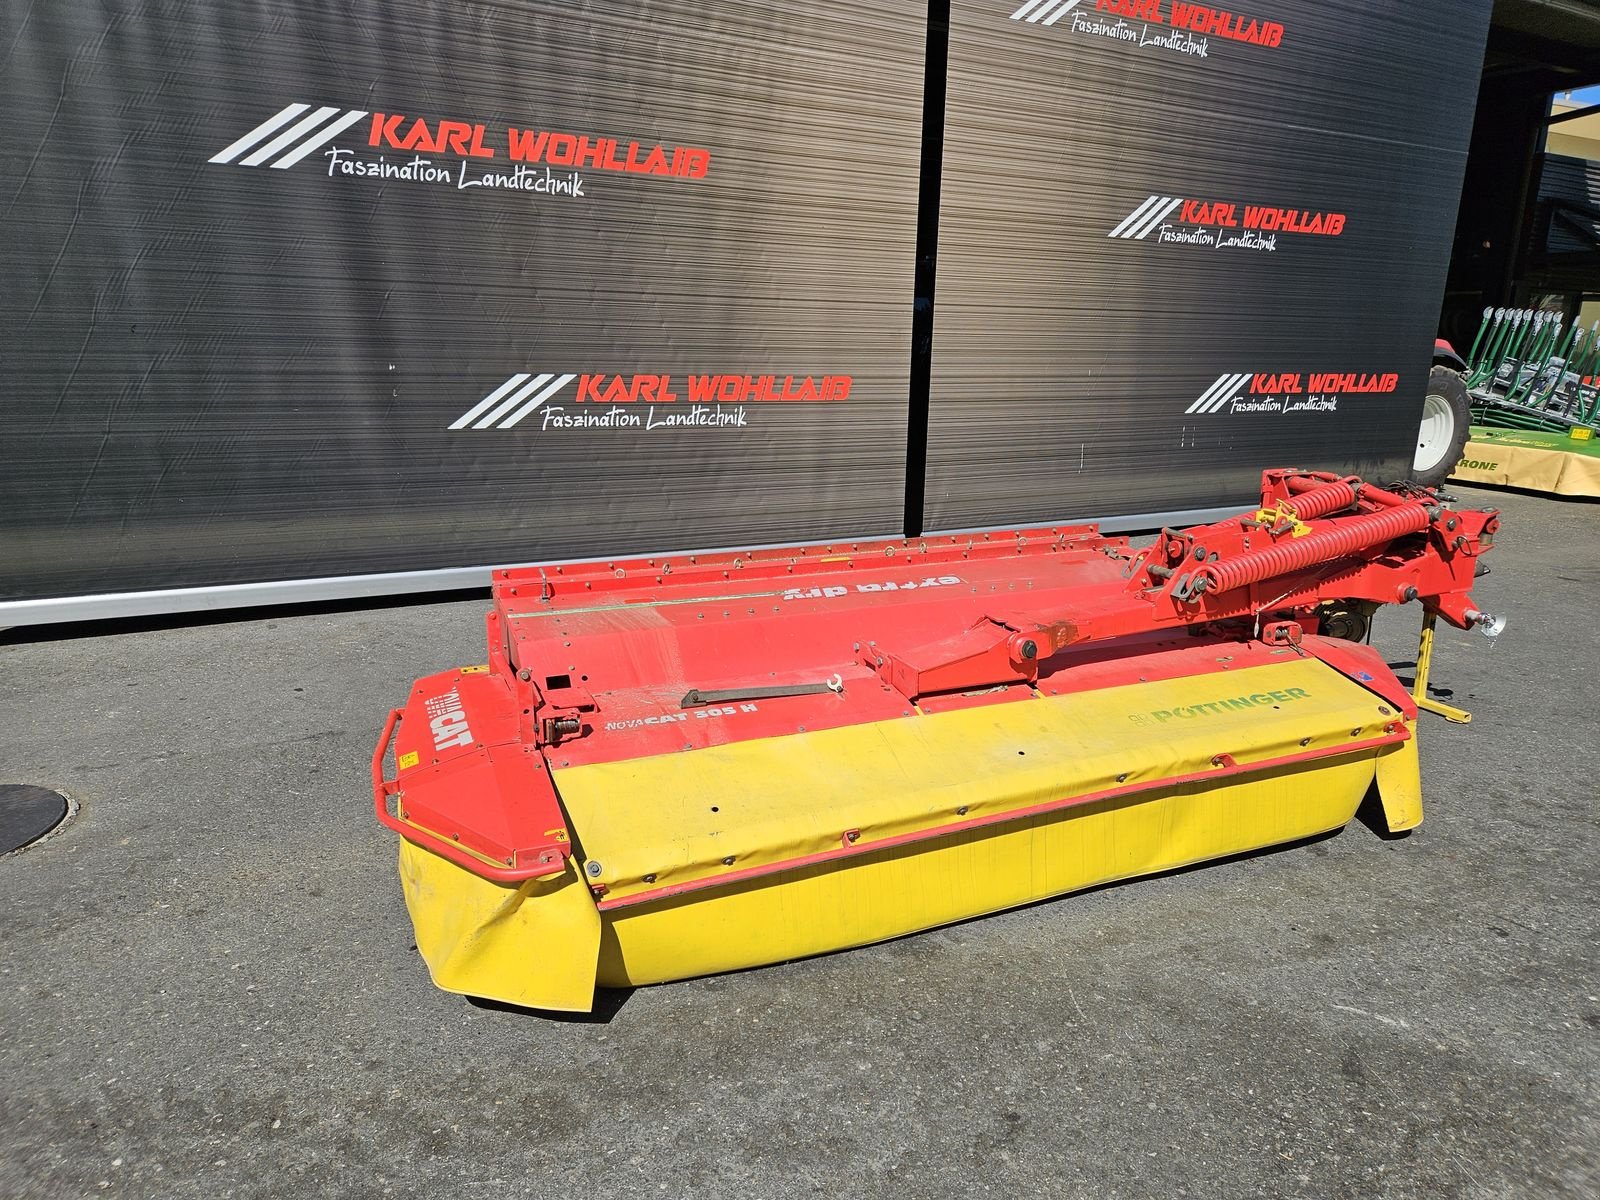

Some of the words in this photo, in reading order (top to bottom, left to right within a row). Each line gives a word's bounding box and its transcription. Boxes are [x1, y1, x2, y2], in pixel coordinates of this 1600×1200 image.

[1072, 9, 1137, 41] Faszination
[1139, 24, 1209, 58] Landtechnik
[368, 112, 495, 158] KARL
[324, 146, 451, 183] Faszination
[457, 160, 585, 198] Landtechnik
[1180, 200, 1237, 227] KARL
[1158, 223, 1214, 245] Faszination
[1215, 229, 1277, 252] Landtechnik
[575, 374, 677, 403] KARL
[1249, 373, 1303, 394] KARL
[539, 404, 641, 431] Faszination
[645, 404, 747, 431] Landtechnik
[1230, 395, 1281, 415] Faszination
[1282, 395, 1337, 414] Landtechnik
[783, 585, 848, 600] dry
[856, 576, 961, 593] extra
[605, 713, 688, 731] NOVACAT
[694, 706, 737, 719] 305
[740, 703, 758, 713] H
